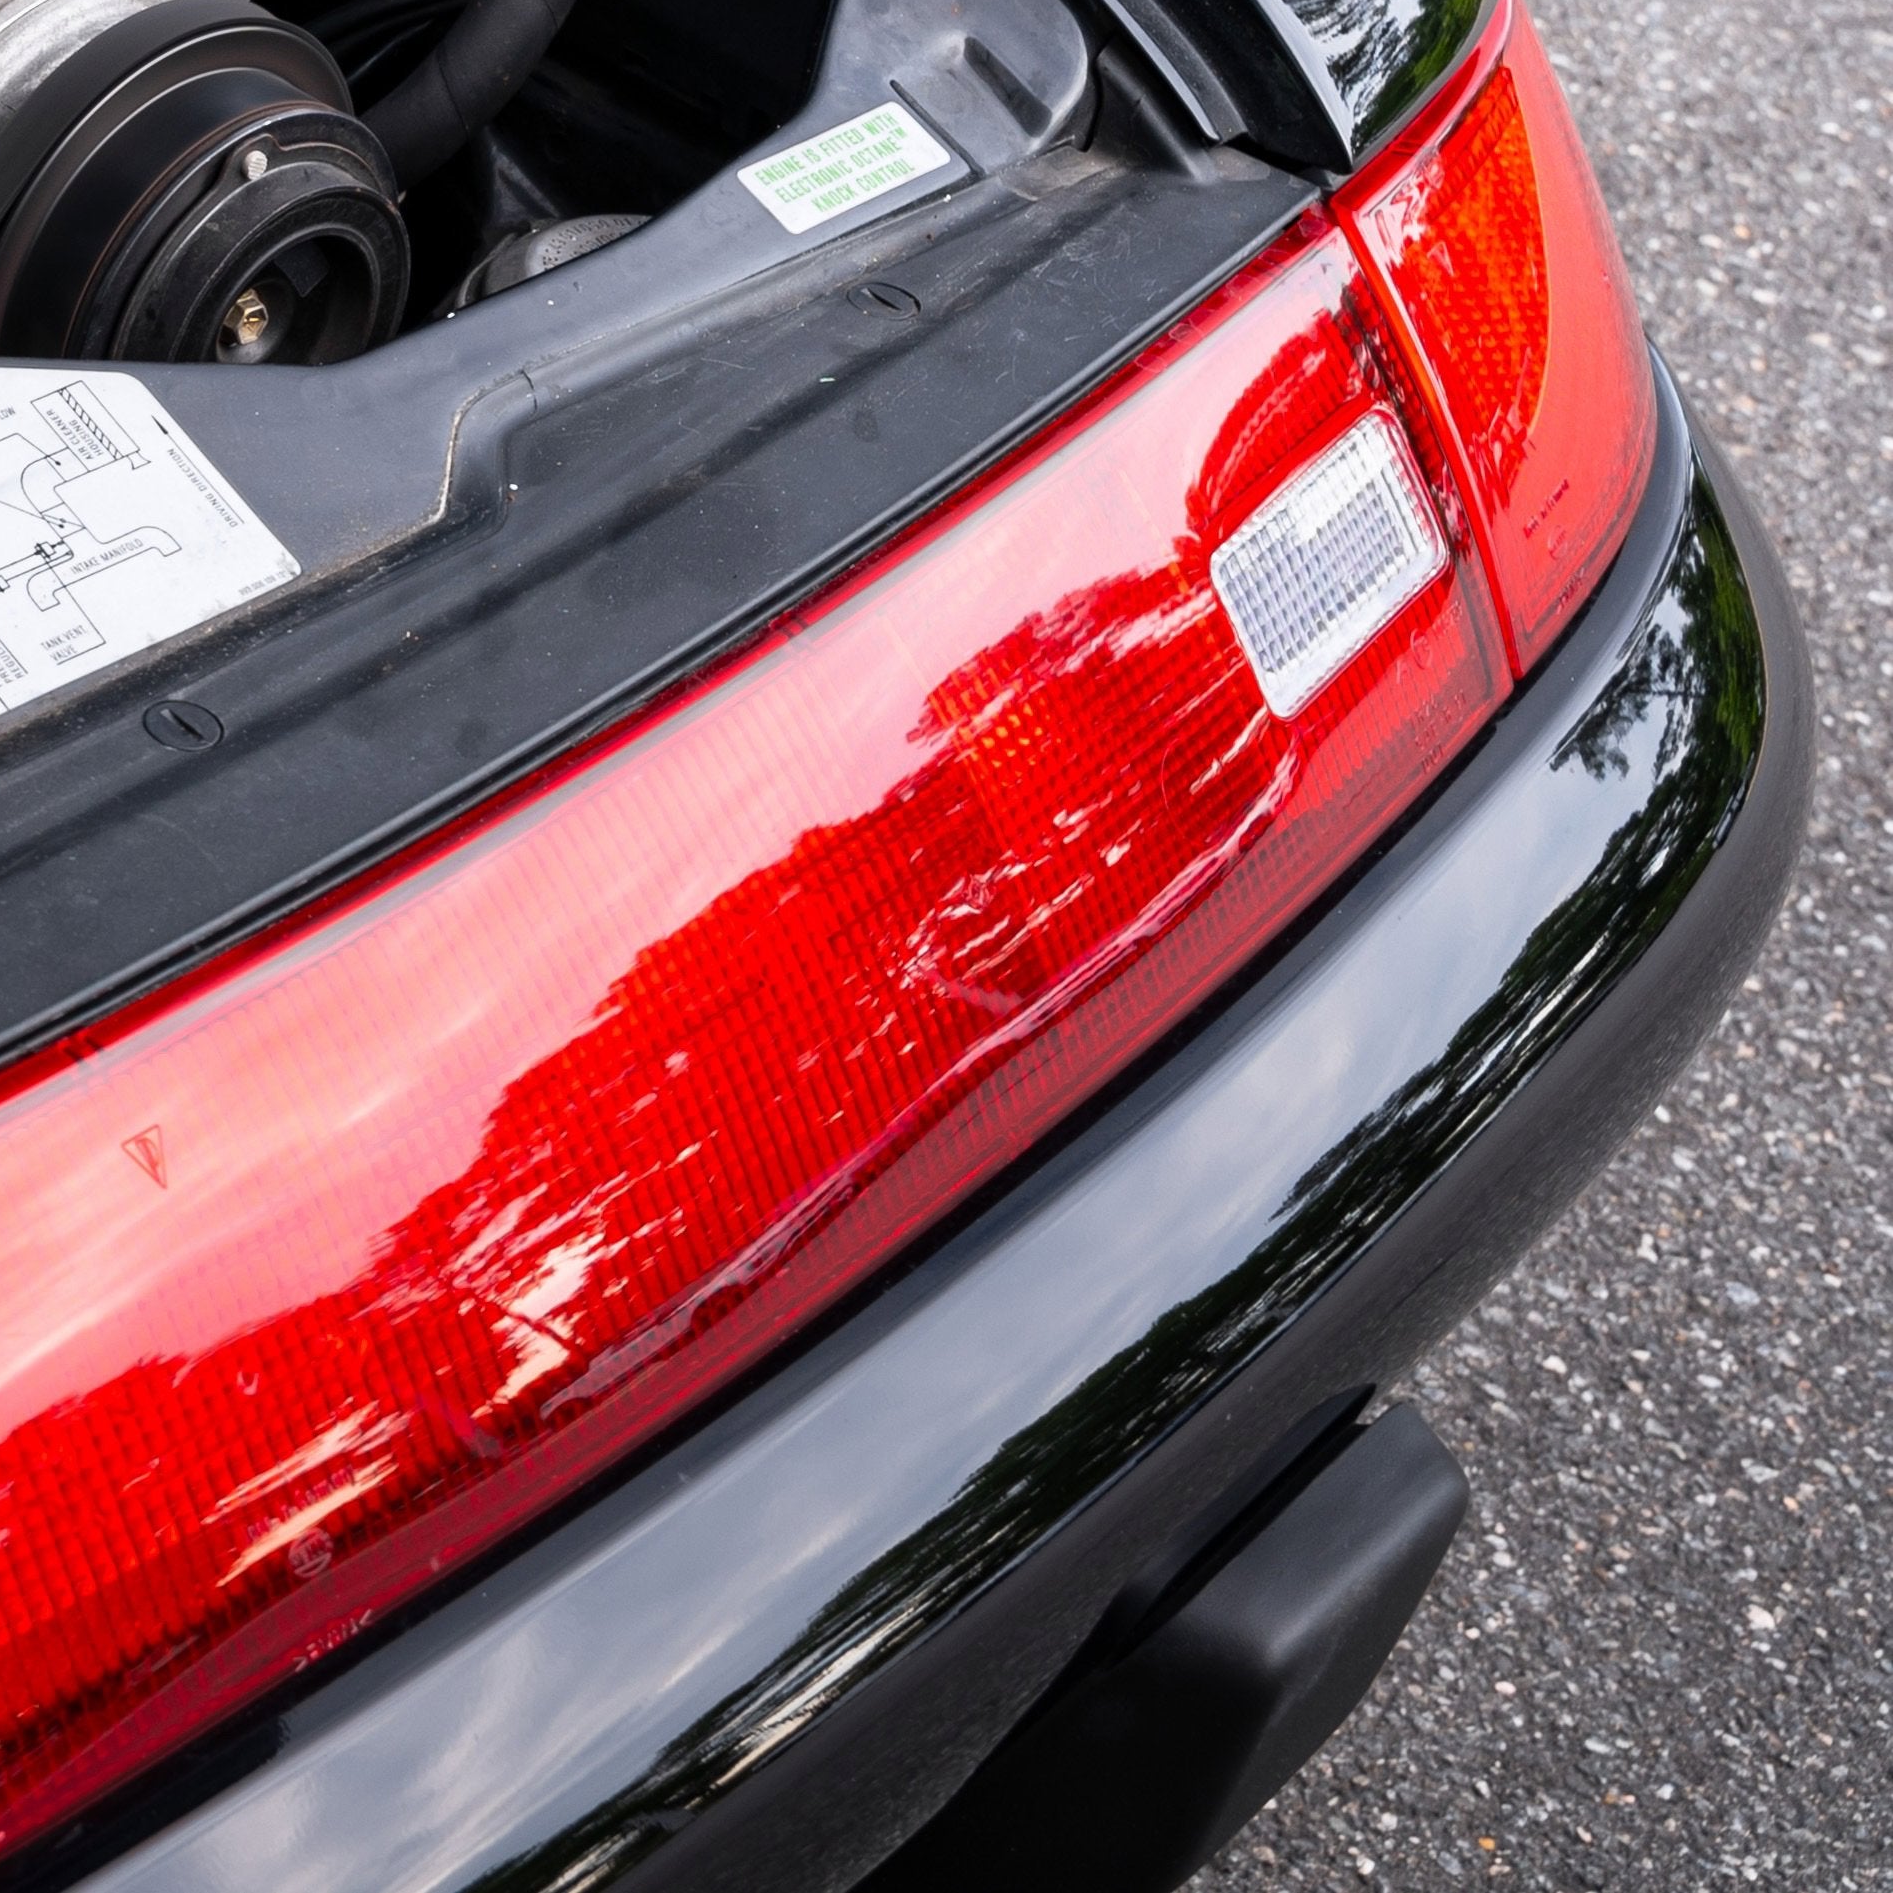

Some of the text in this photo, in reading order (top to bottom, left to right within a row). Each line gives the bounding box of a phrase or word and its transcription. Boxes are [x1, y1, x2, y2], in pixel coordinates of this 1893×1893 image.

[753, 111, 900, 186] ENGINE IS FITTED WITH
[773, 158, 854, 204] ELECTRONIC
[809, 155, 916, 213] KNOCK CONTROL
[44, 408, 95, 461] AIR CLEANER
[68, 418, 105, 456] HOUSING
[165, 447, 239, 528] DRIVING DIRECTION
[68, 536, 145, 576] INTAKE MANIFOLD
[39, 634, 65, 651] TANK
[49, 644, 78, 662] VALVE
